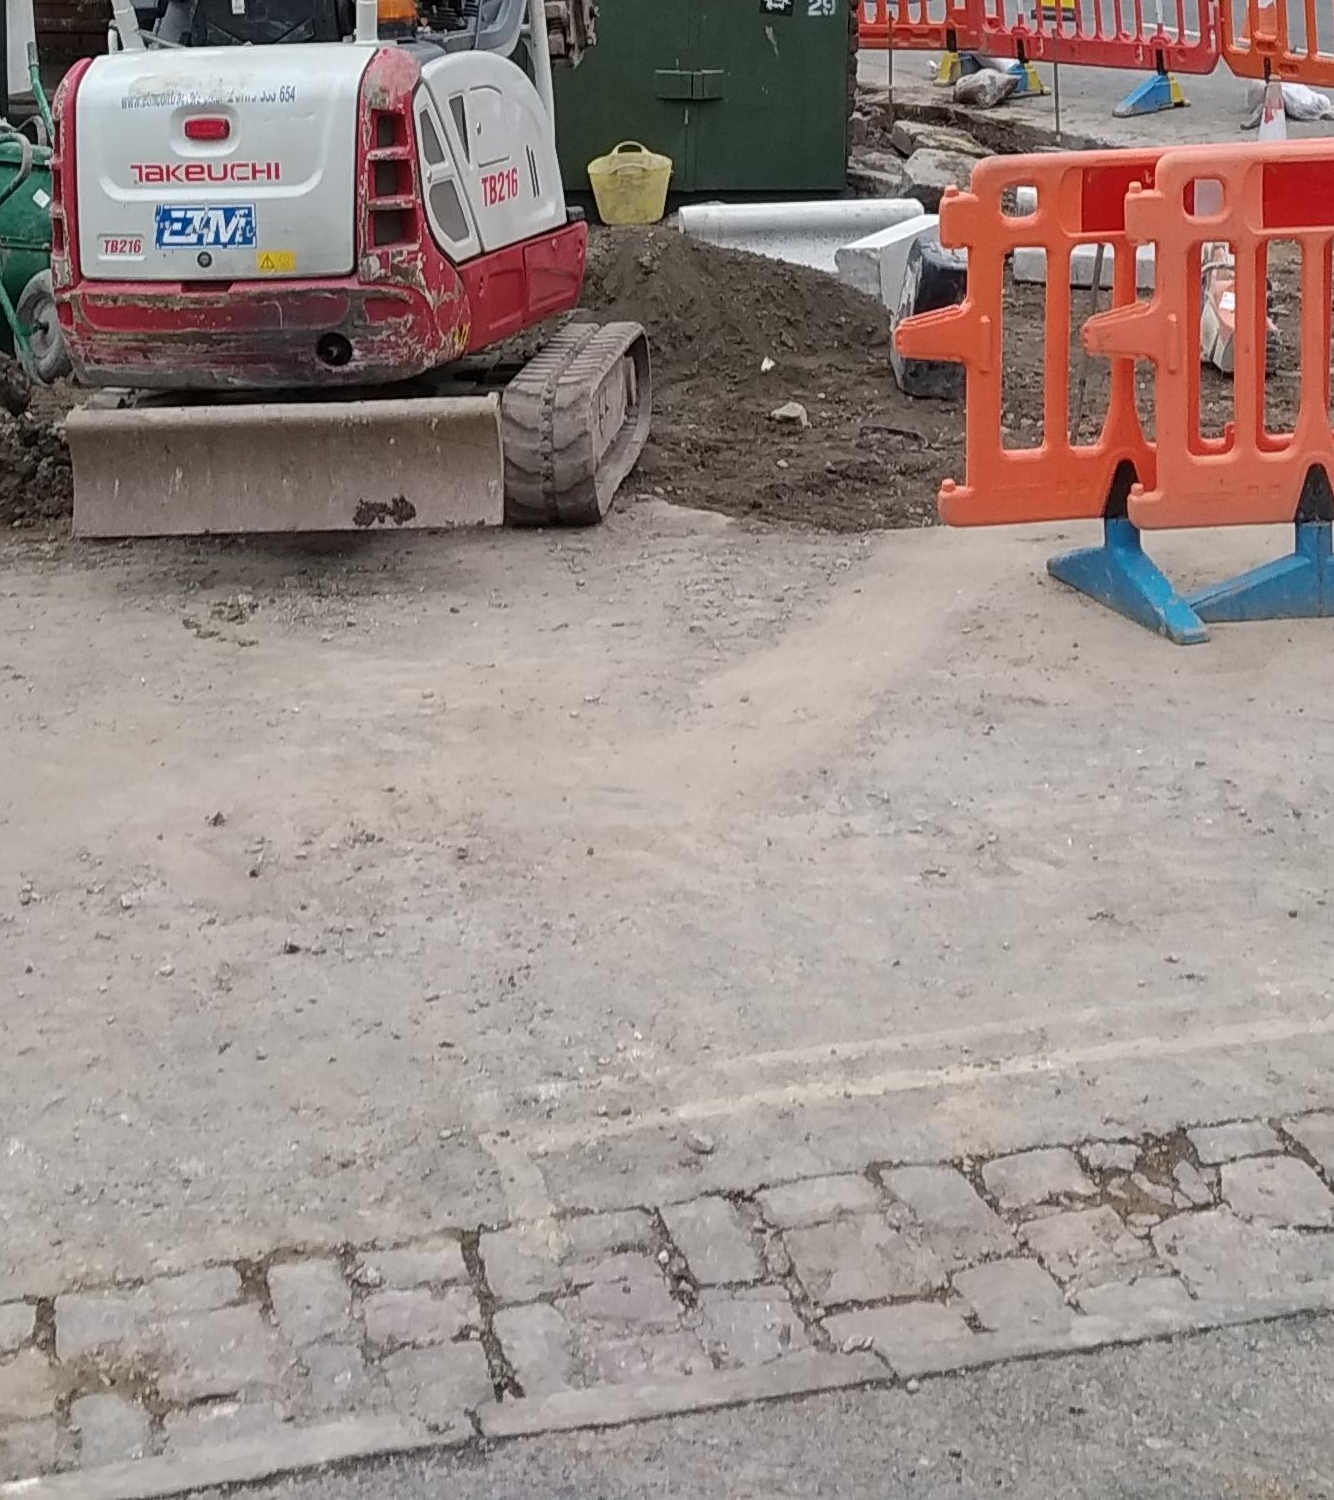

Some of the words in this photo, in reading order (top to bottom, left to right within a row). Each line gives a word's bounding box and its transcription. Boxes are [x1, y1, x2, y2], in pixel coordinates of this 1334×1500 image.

[279, 85, 296, 103] 654
[481, 167, 518, 208] TB216
[103, 239, 142, 254] TB216
